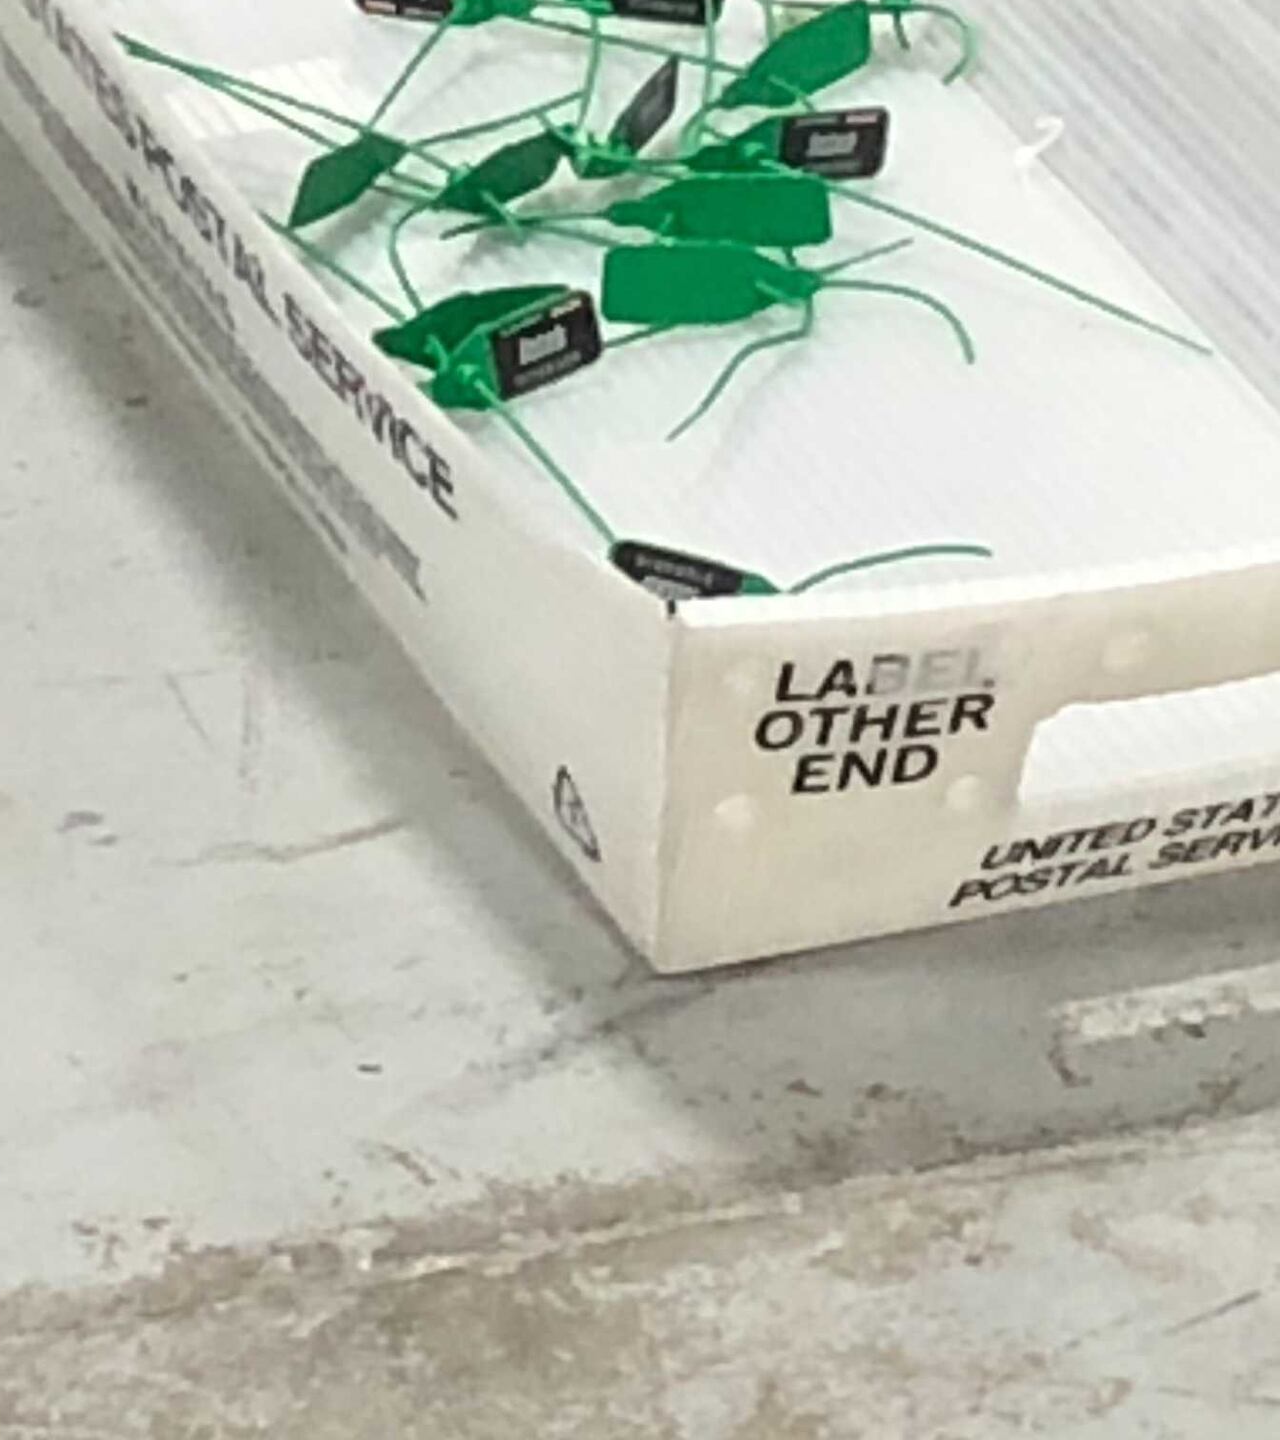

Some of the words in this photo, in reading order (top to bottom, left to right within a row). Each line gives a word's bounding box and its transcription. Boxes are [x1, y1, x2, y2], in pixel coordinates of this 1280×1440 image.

[754, 693, 995, 750] OTHER
[791, 744, 938, 795] END
[980, 817, 1157, 871] UNITED
[948, 852, 1133, 908] POSTAL
